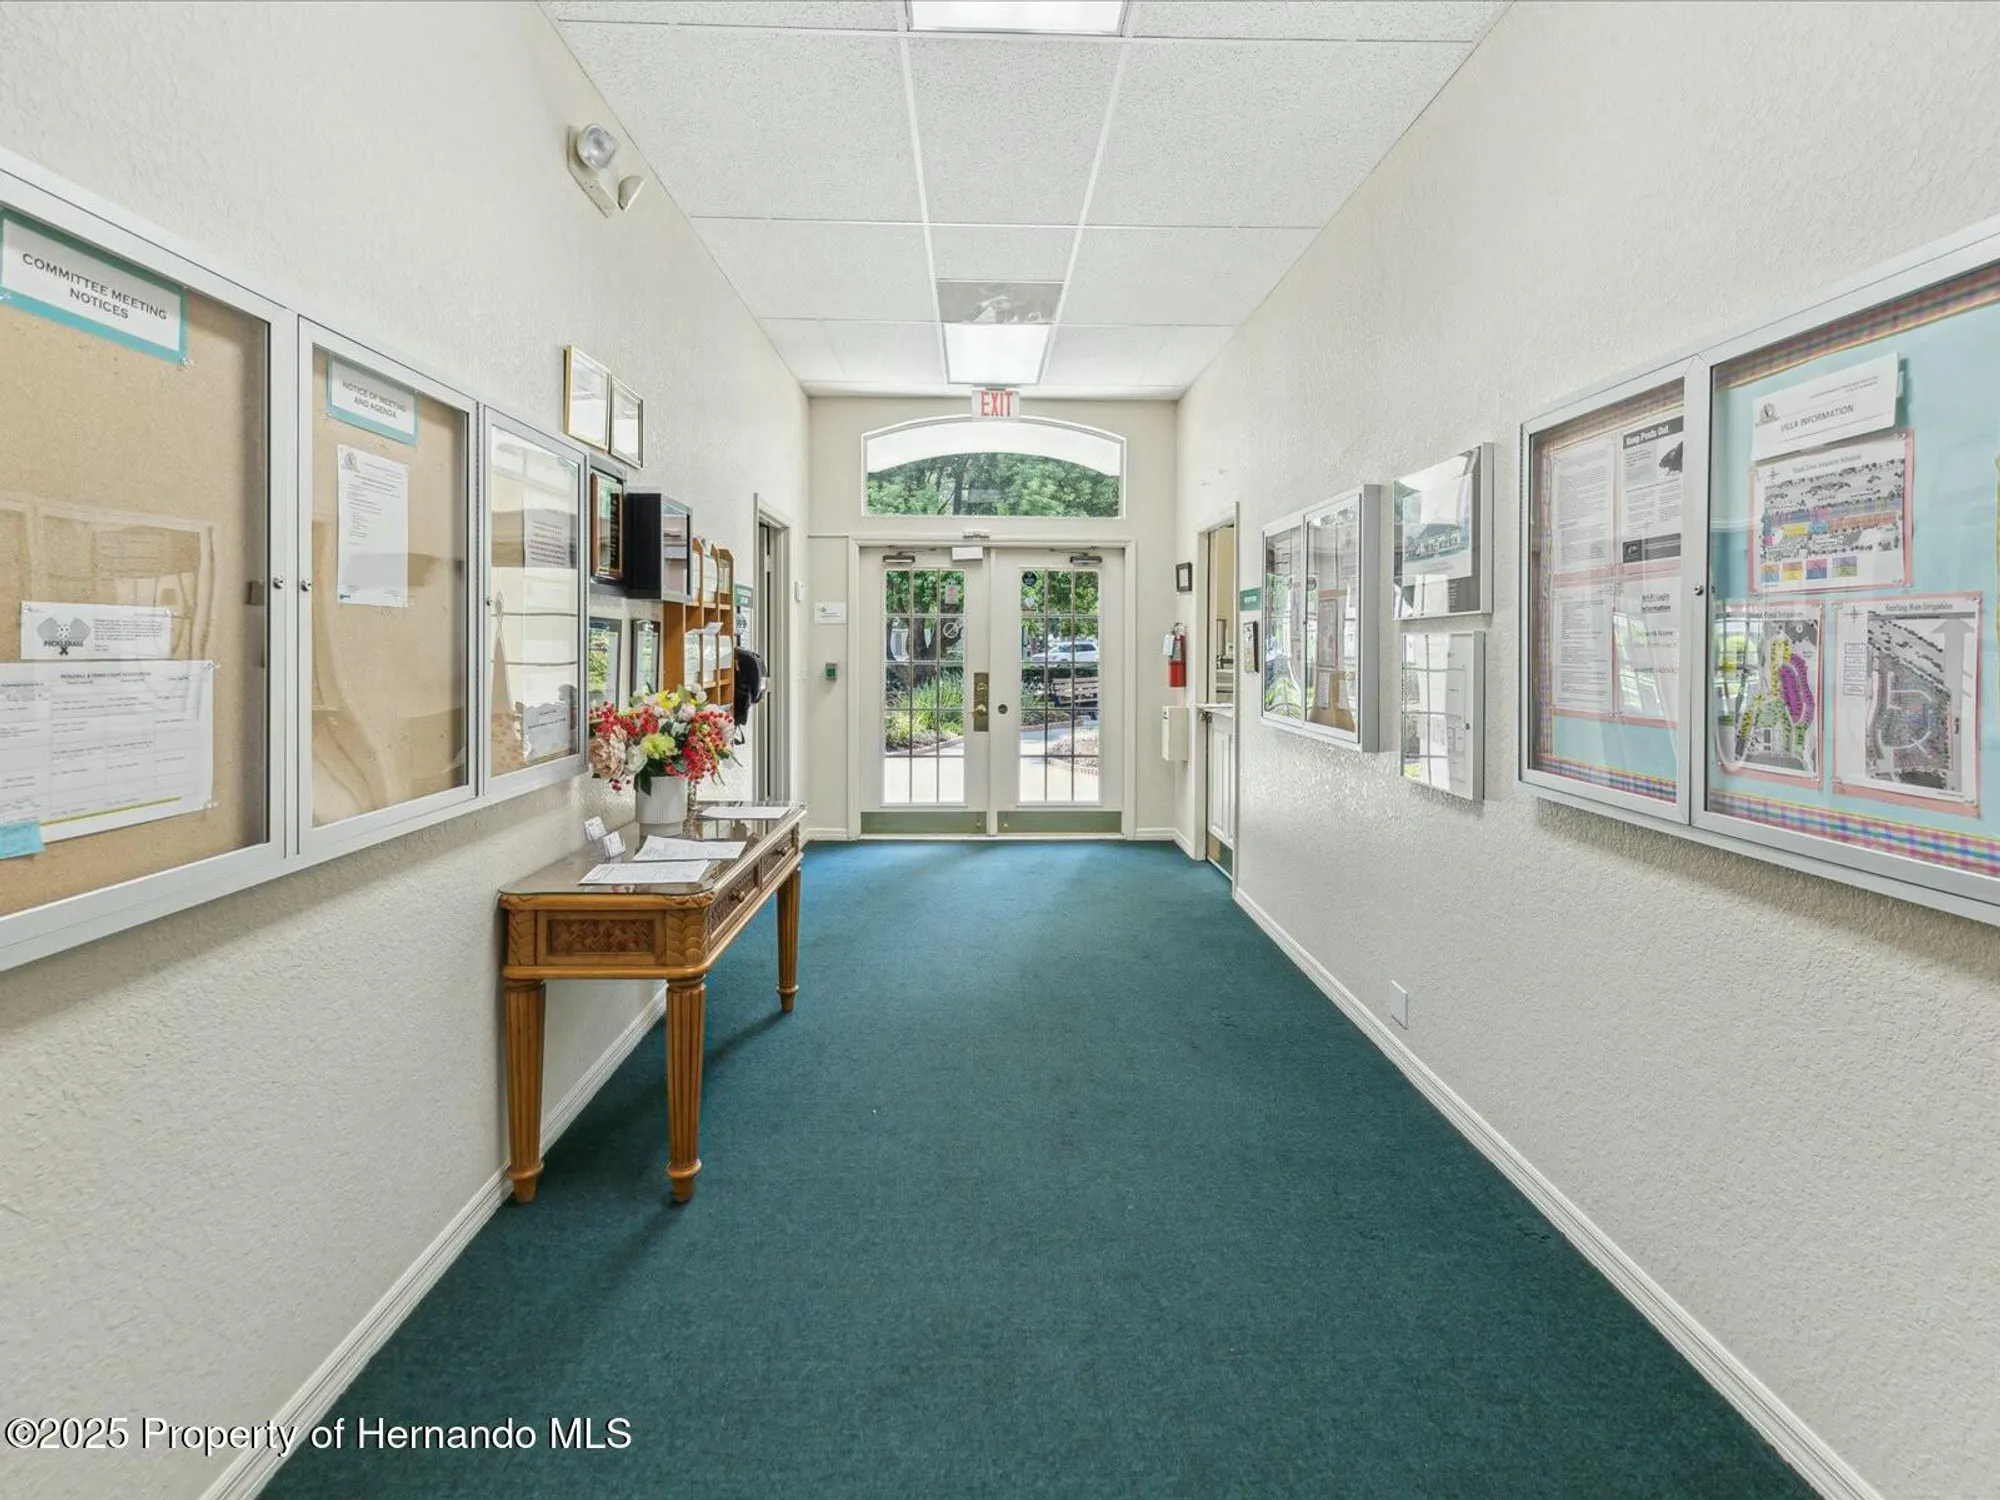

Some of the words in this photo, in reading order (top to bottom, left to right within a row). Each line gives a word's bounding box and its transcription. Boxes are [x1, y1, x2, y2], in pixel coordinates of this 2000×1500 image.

[22, 253, 109, 296] COMMITTEE
[111, 290, 167, 320] MEETING
[69, 288, 129, 319] NOTICES
[981, 391, 1013, 417] EXIT
[1800, 404, 1855, 427] INFORMATION
